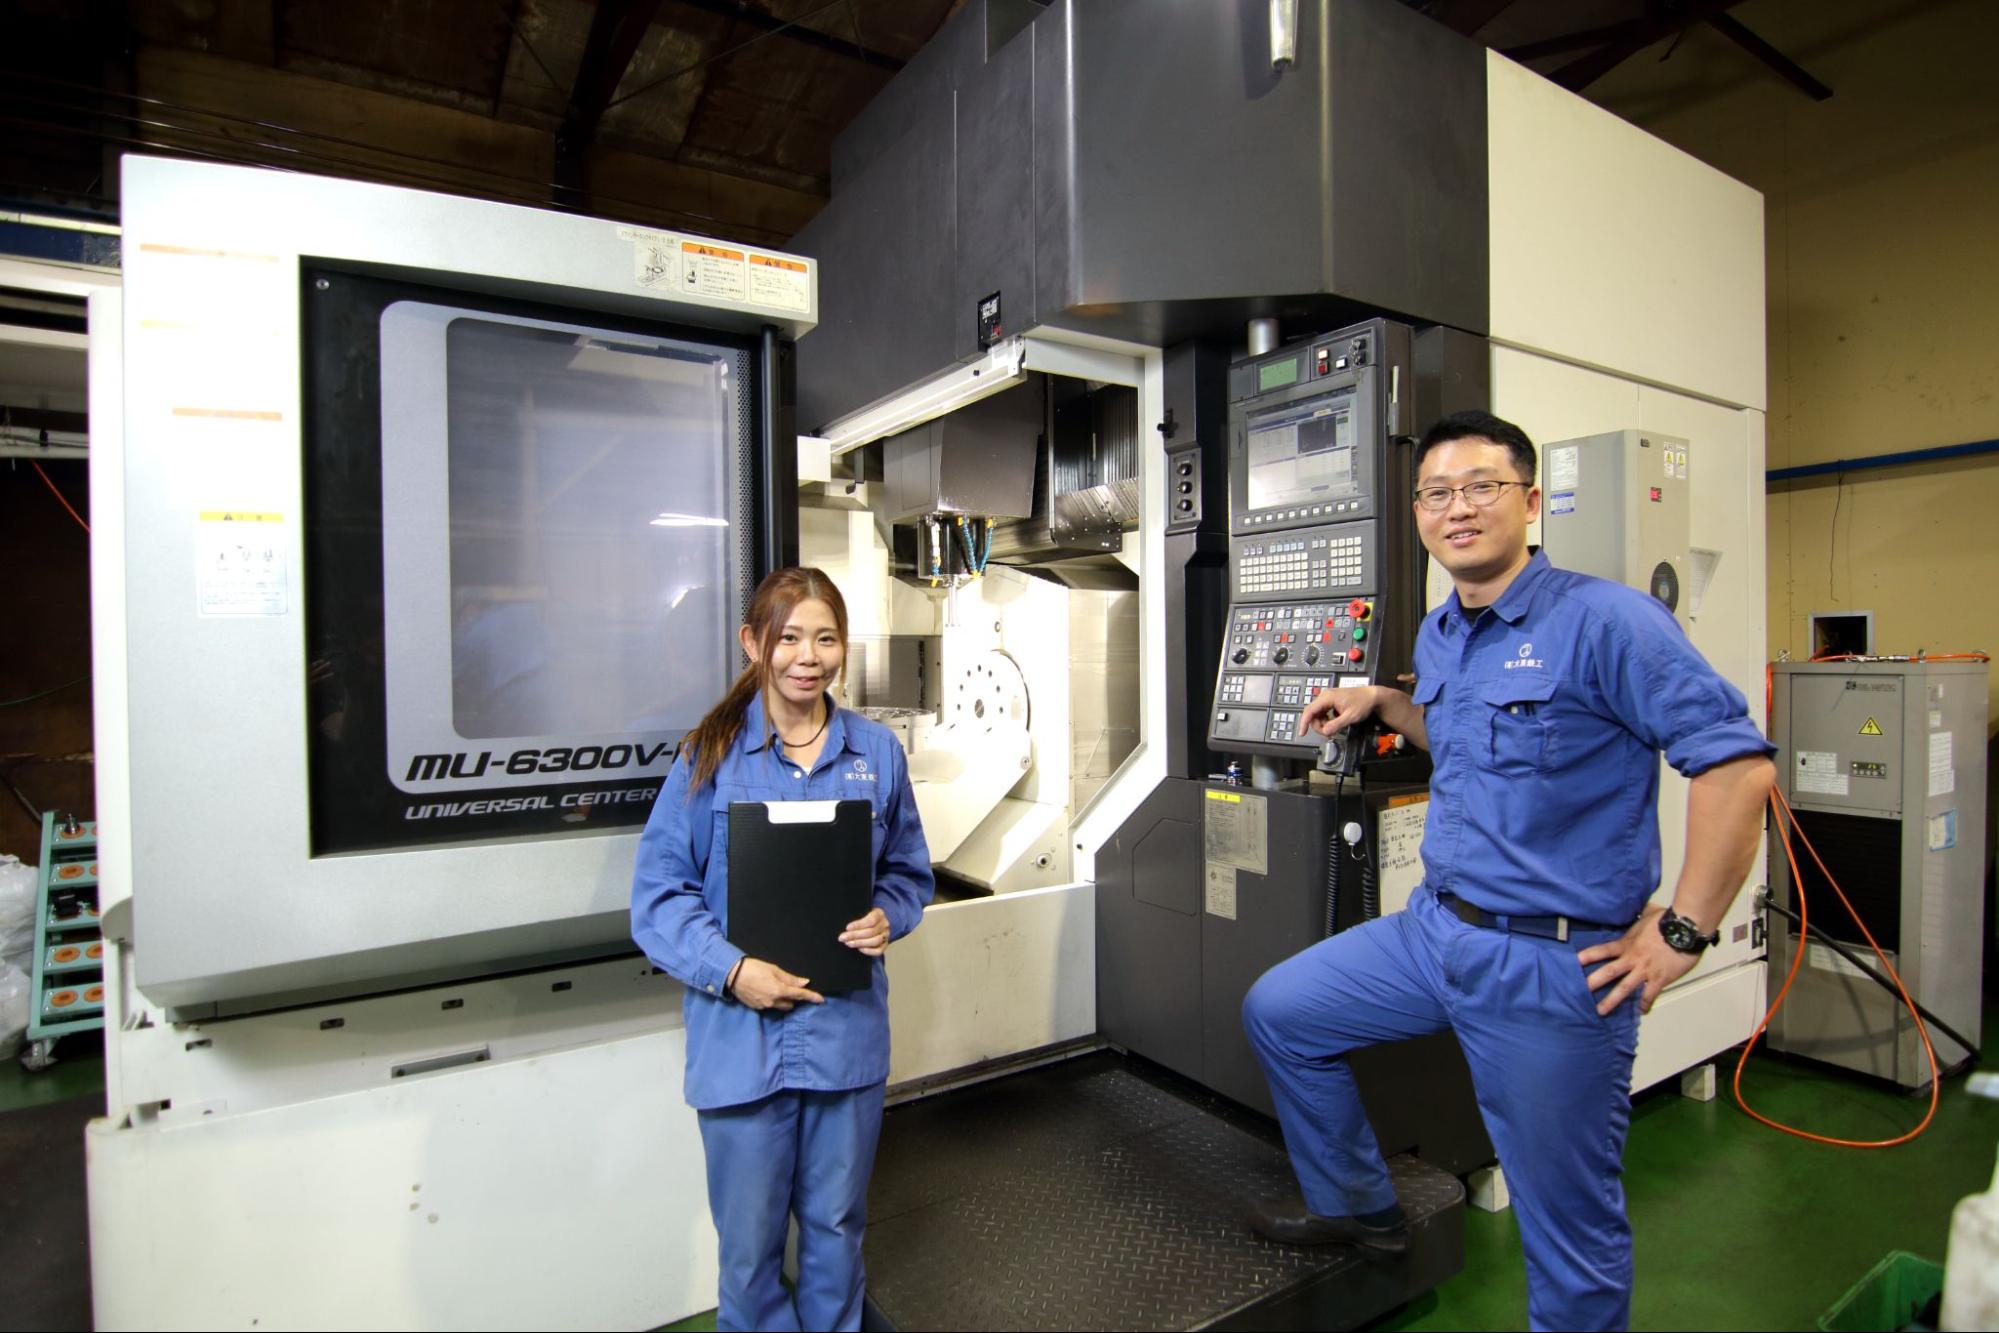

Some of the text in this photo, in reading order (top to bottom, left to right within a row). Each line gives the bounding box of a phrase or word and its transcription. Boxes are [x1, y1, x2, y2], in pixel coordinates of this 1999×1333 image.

[405, 742, 682, 781] MU-6300V-
[405, 788, 657, 820] UNIVERSAL CENTER
